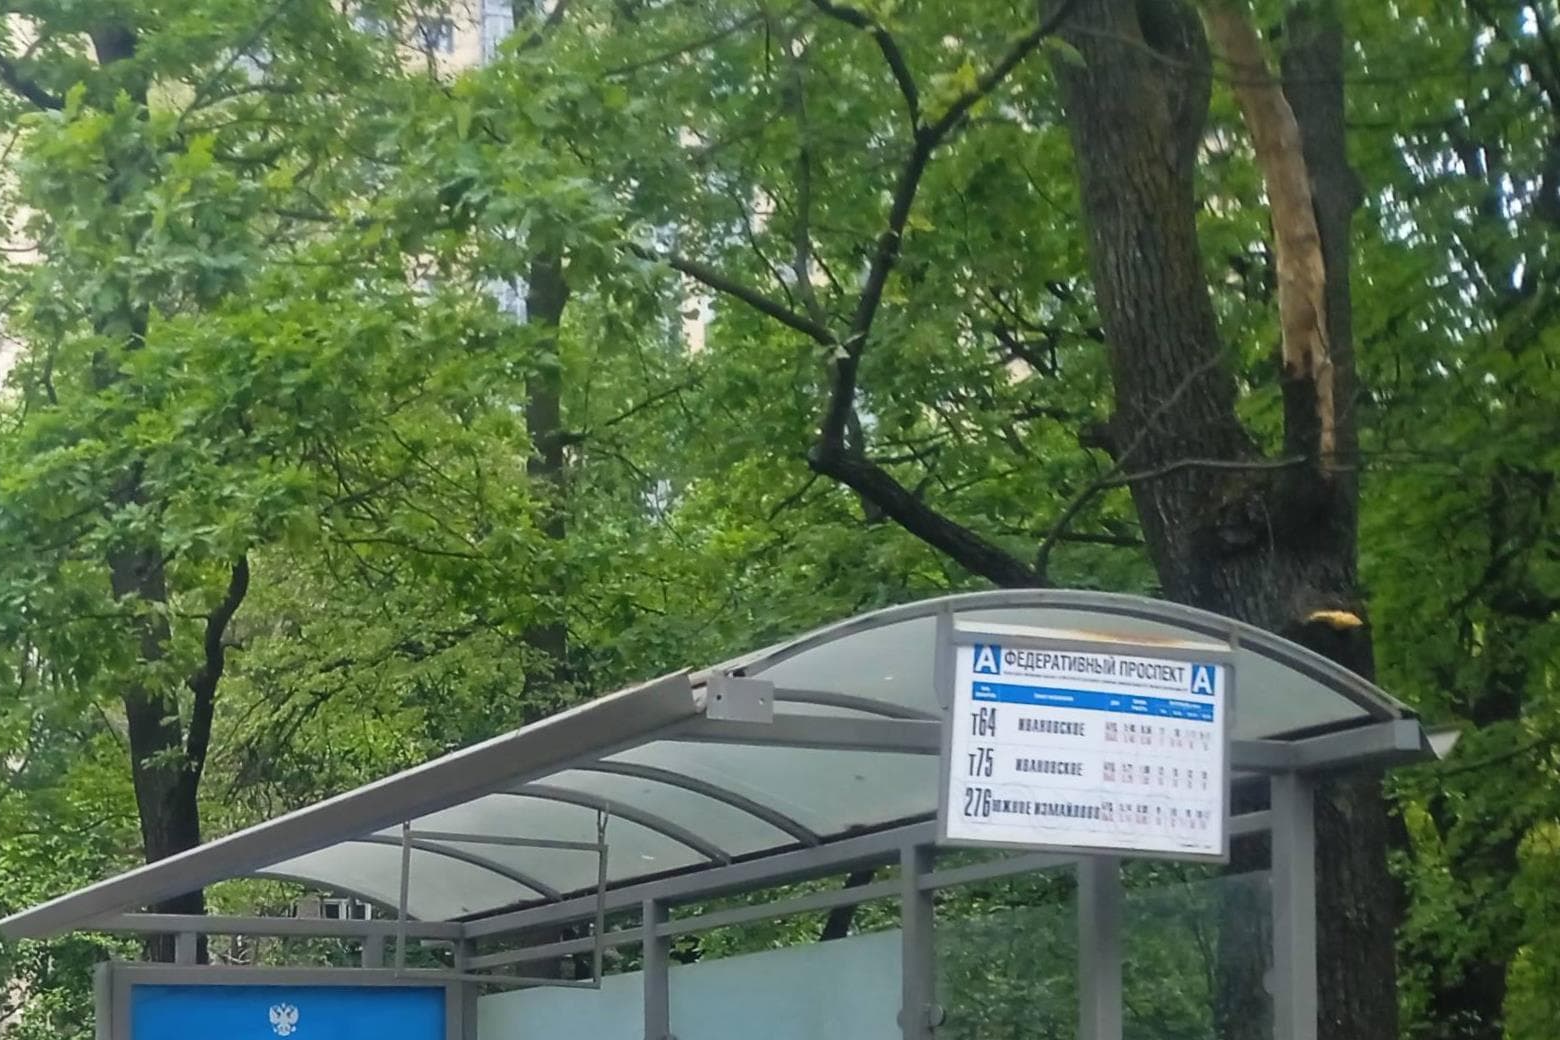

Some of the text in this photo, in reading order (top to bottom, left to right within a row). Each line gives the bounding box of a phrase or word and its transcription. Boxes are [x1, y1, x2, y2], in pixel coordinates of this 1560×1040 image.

[974, 646, 998, 673] А
[1004, 650, 1116, 676] ФЕДЕРАТИВНЫЙ
[1120, 660, 1185, 683] ПРОСПЕКТ
[1193, 666, 1212, 694] А
[1018, 718, 1086, 737] ИВАНОВСКОЕ
[1015, 758, 1083, 776] ИВАНОВСКОЕ
[964, 787, 992, 817] 276
